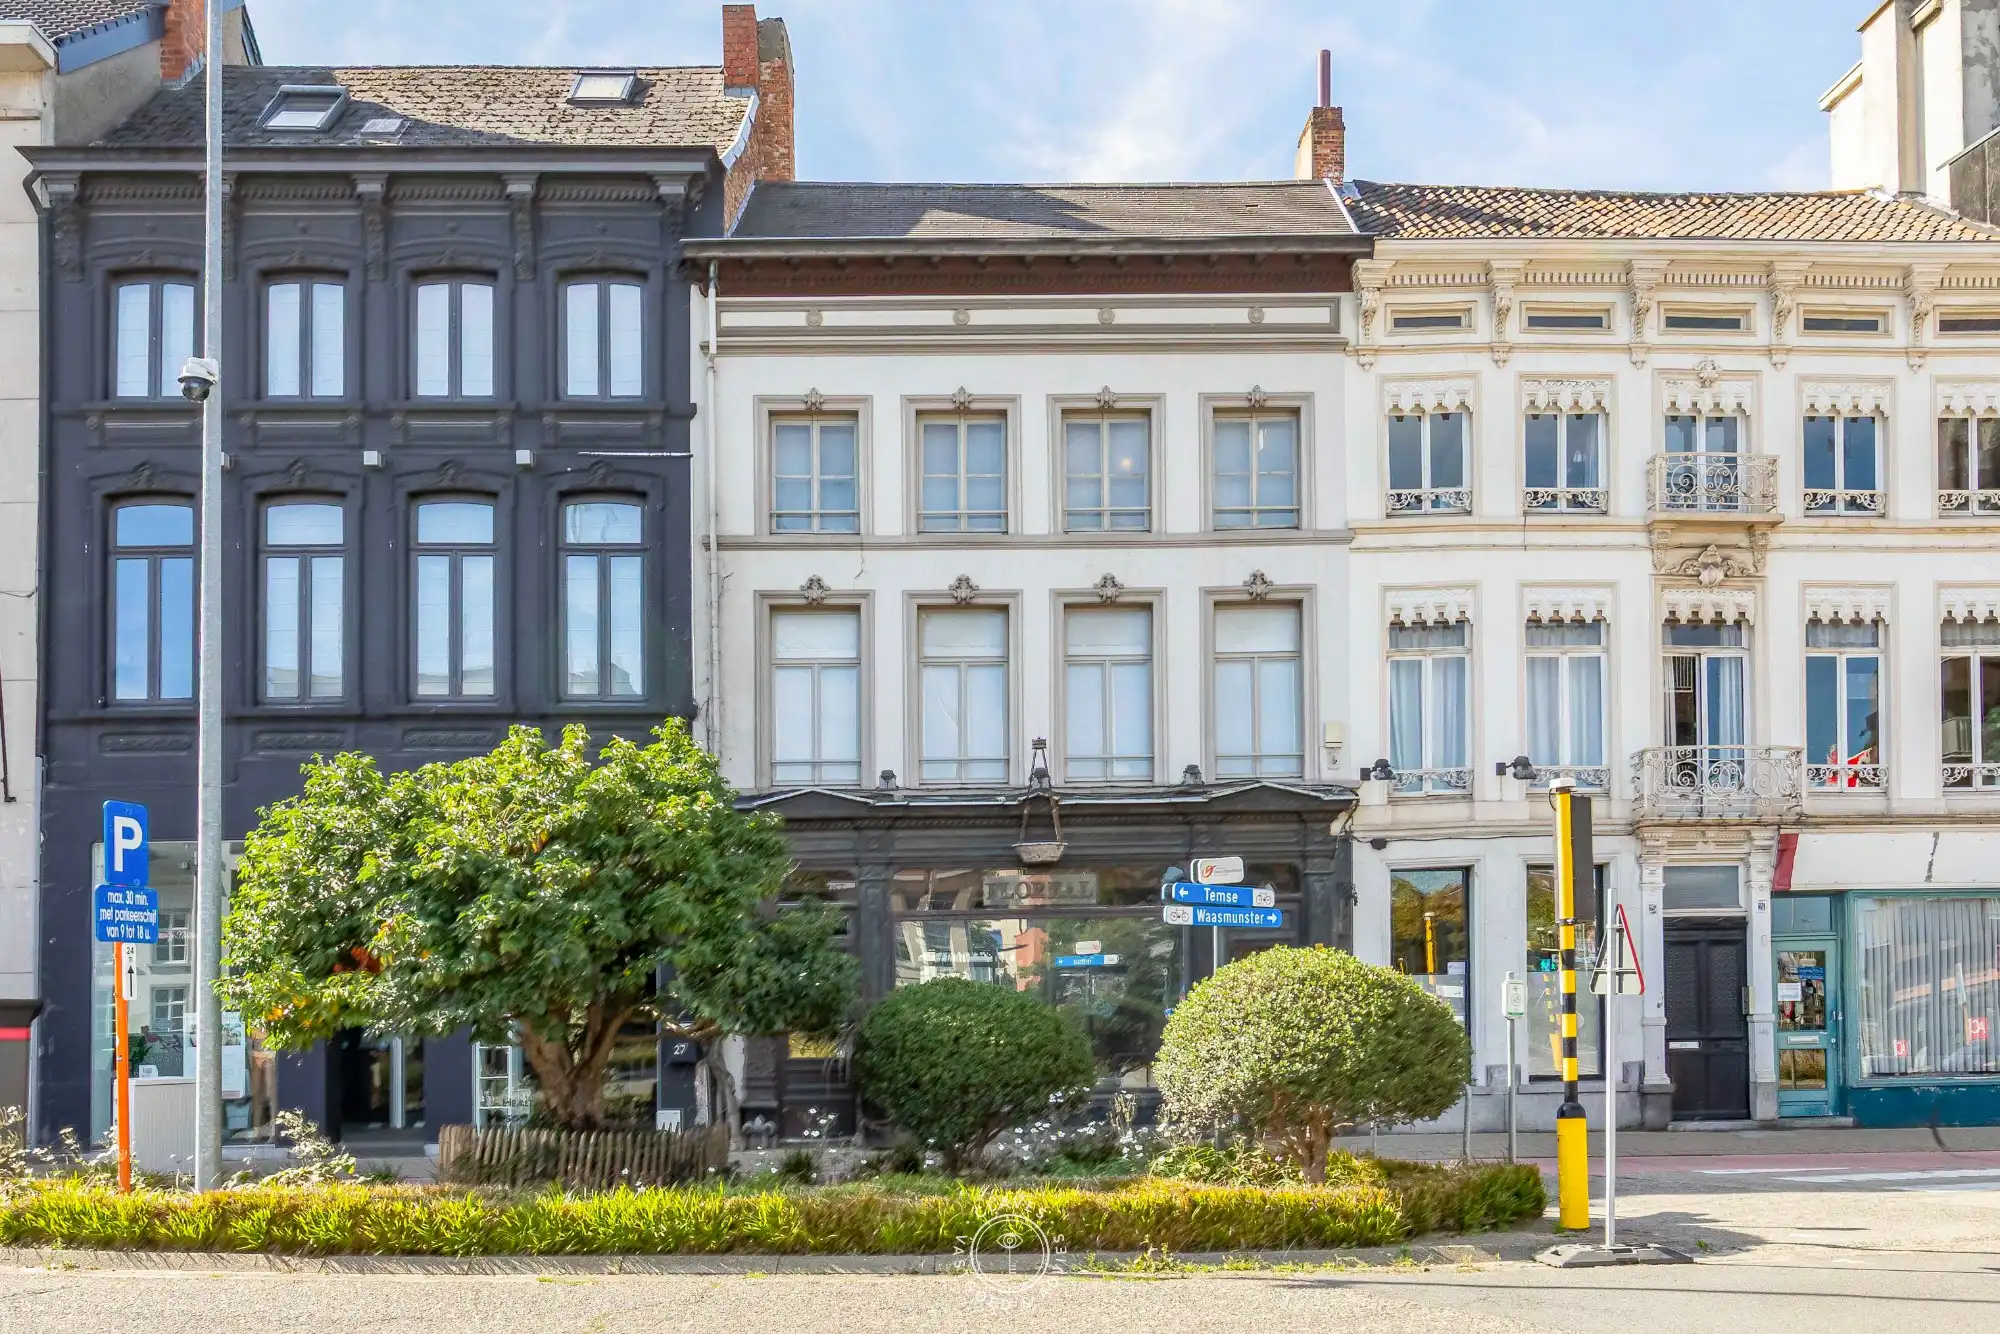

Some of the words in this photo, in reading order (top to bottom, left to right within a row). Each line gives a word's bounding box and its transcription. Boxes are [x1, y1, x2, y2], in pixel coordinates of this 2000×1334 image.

[114, 816, 143, 872] P
[107, 891, 125, 904] max.
[125, 890, 134, 905] 30
[134, 891, 149, 906] min.
[1204, 887, 1239, 903] Temse
[99, 906, 113, 920] met
[114, 907, 157, 926] parkeerschijf
[1196, 908, 1265, 925] Waasmunster
[106, 925, 120, 938] van
[120, 923, 125, 938] 9
[125, 924, 135, 938] tot
[136, 925, 144, 939] 18
[126, 946, 134, 955] 24
[673, 1043, 687, 1056] 27
